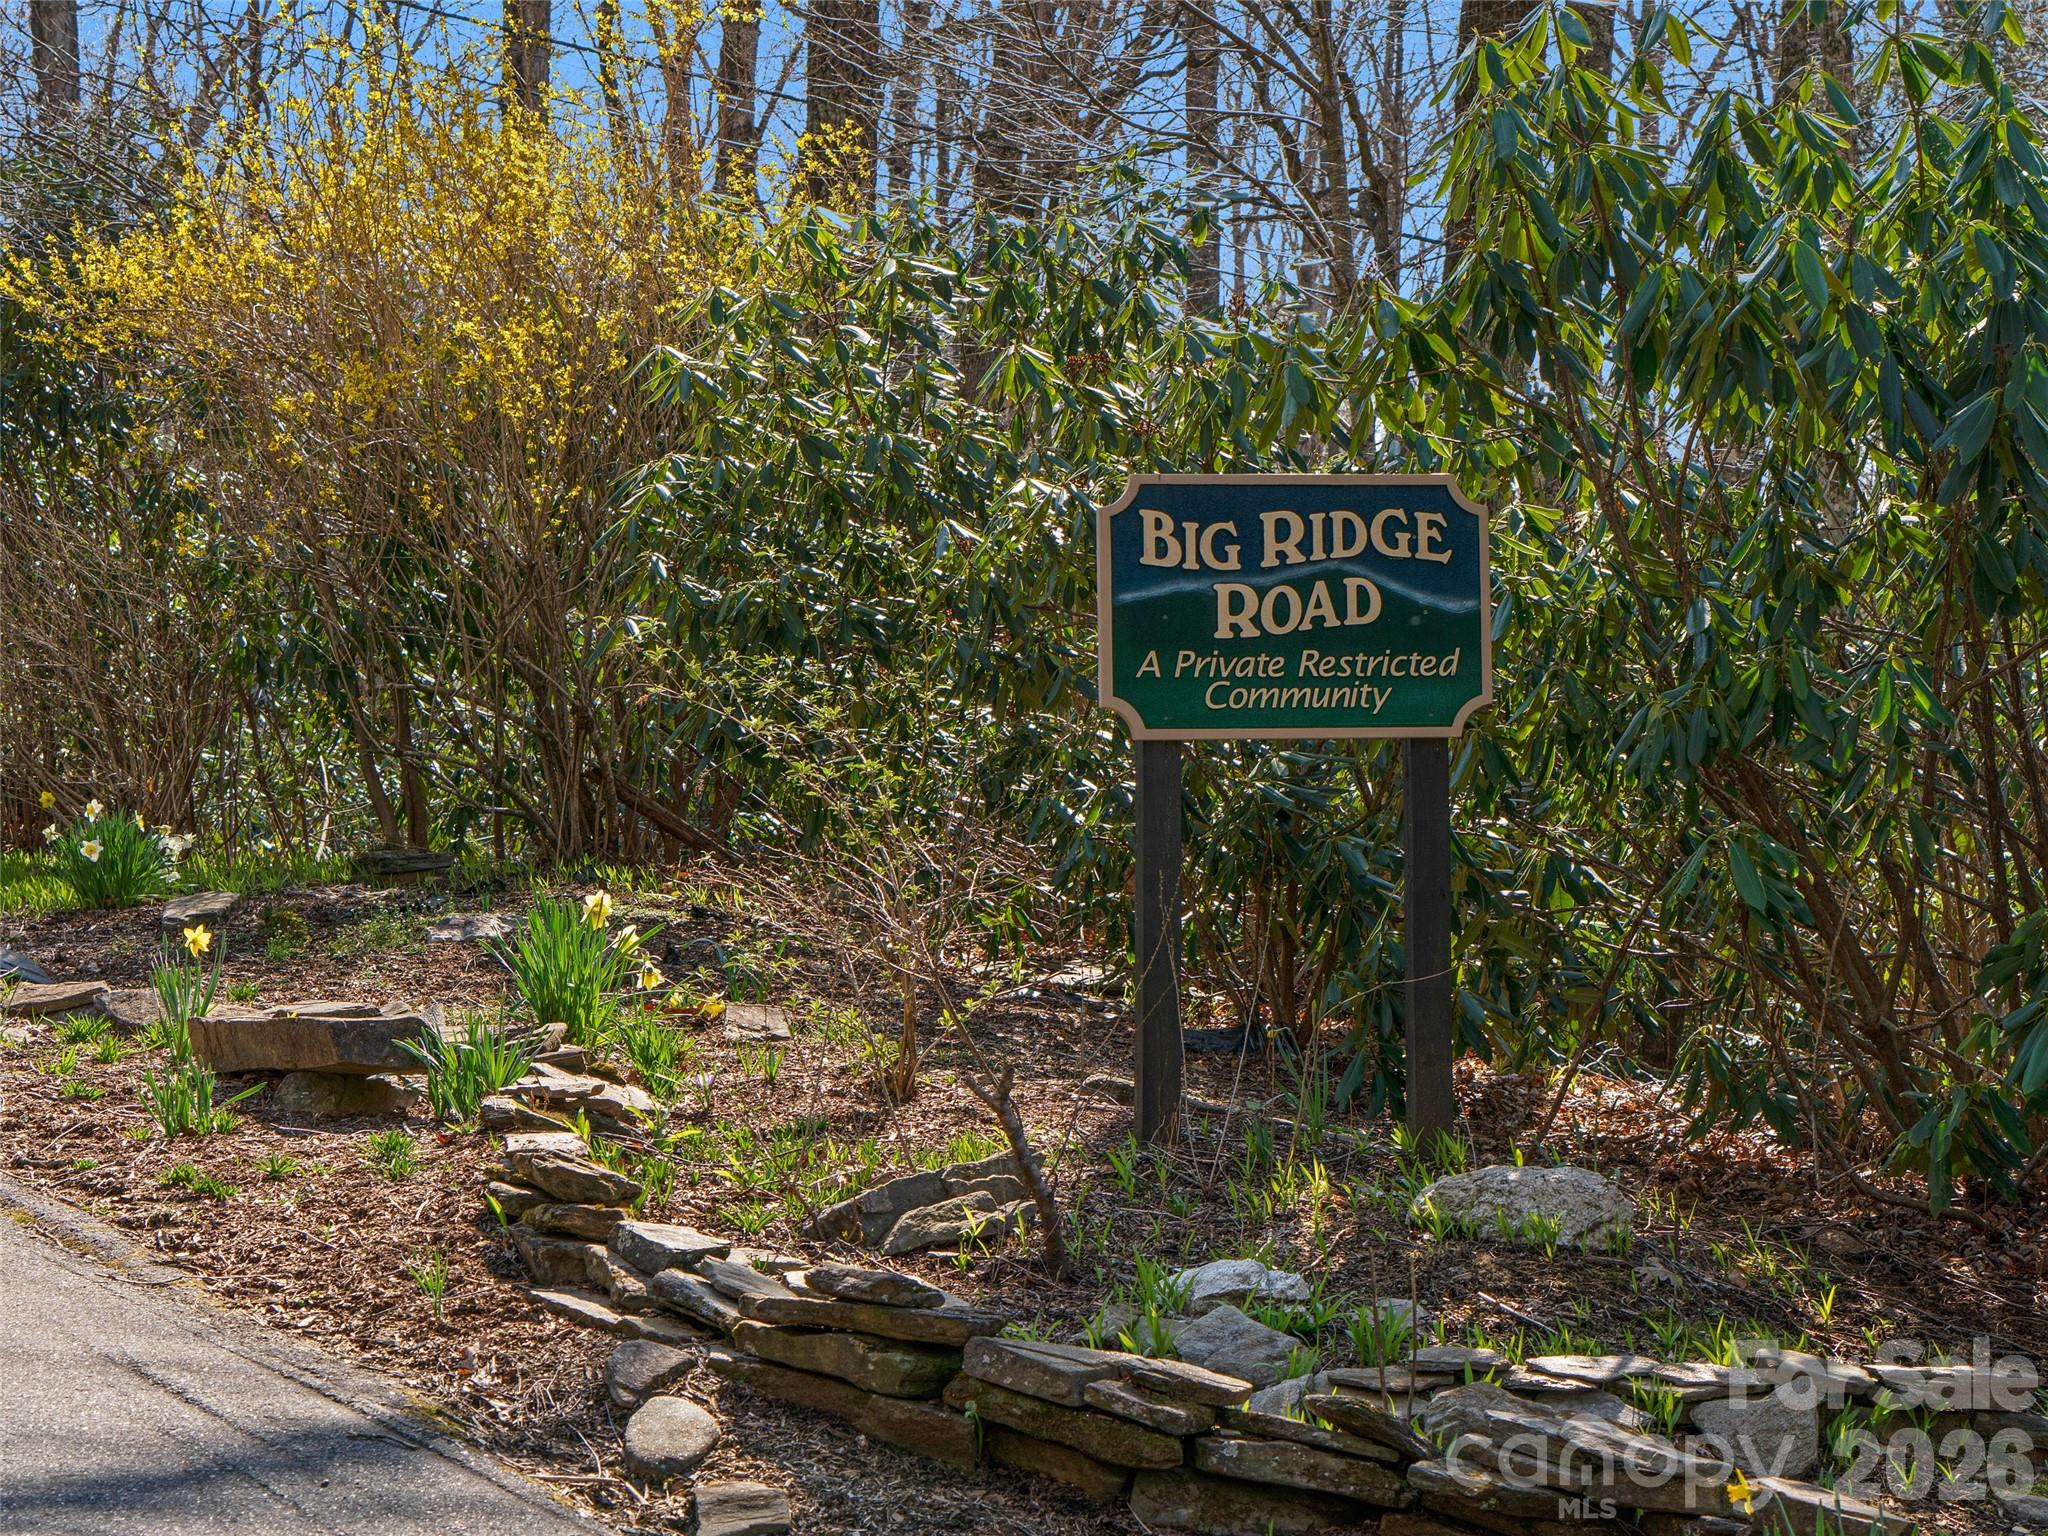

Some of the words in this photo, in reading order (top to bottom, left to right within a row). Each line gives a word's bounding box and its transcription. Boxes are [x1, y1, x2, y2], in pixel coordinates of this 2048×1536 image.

[1138, 508, 1241, 571] BIG
[1259, 508, 1453, 568] RIDGE
[1213, 577, 1382, 639] ROAD
[1136, 650, 1161, 678] A
[1174, 649, 1285, 678] Private
[1299, 648, 1461, 677] Restricted
[1204, 680, 1393, 714] Community
